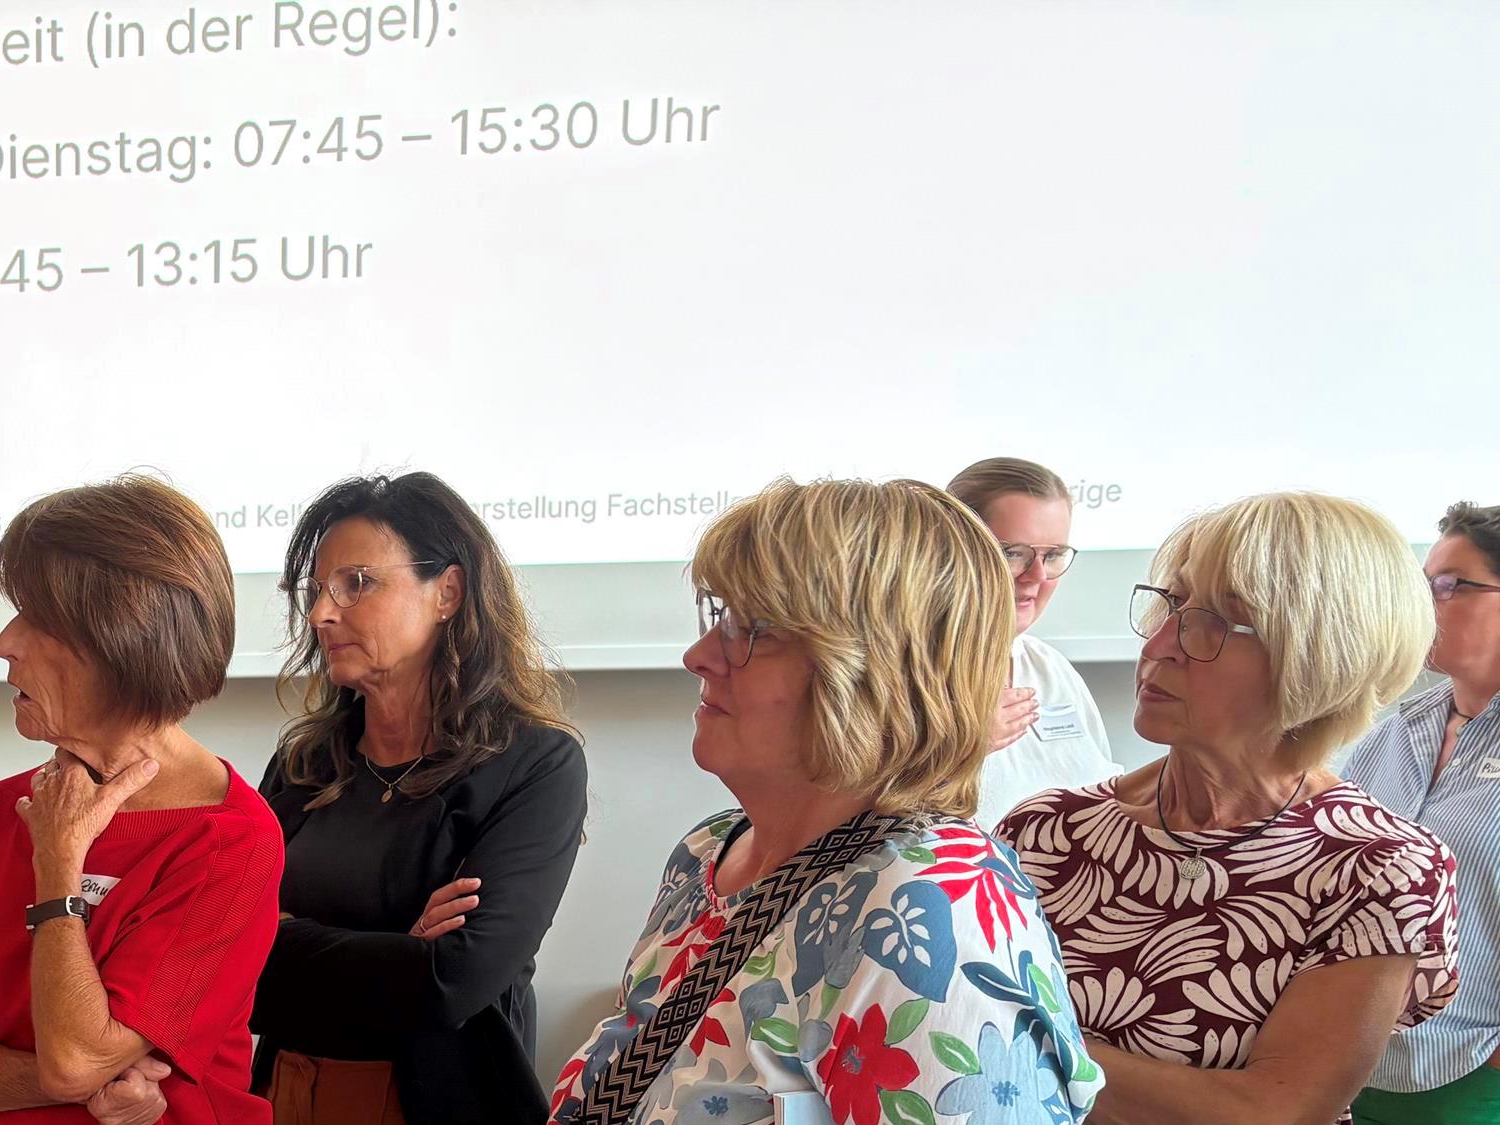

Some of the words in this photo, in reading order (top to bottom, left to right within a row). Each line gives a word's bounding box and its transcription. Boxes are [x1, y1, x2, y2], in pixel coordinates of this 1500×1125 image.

[87, 11, 144, 68] (in
[166, 8, 253, 55] der
[274, 0, 459, 57] Regel):
[234, 115, 383, 167] 07:45
[451, 101, 597, 155] 15:30
[622, 97, 720, 146] Uhr
[128, 238, 258, 287] 13:15
[281, 235, 373, 281] Uhr
[215, 505, 247, 529] nd
[482, 494, 597, 524] rstellung
[607, 490, 730, 518] Fachstell
